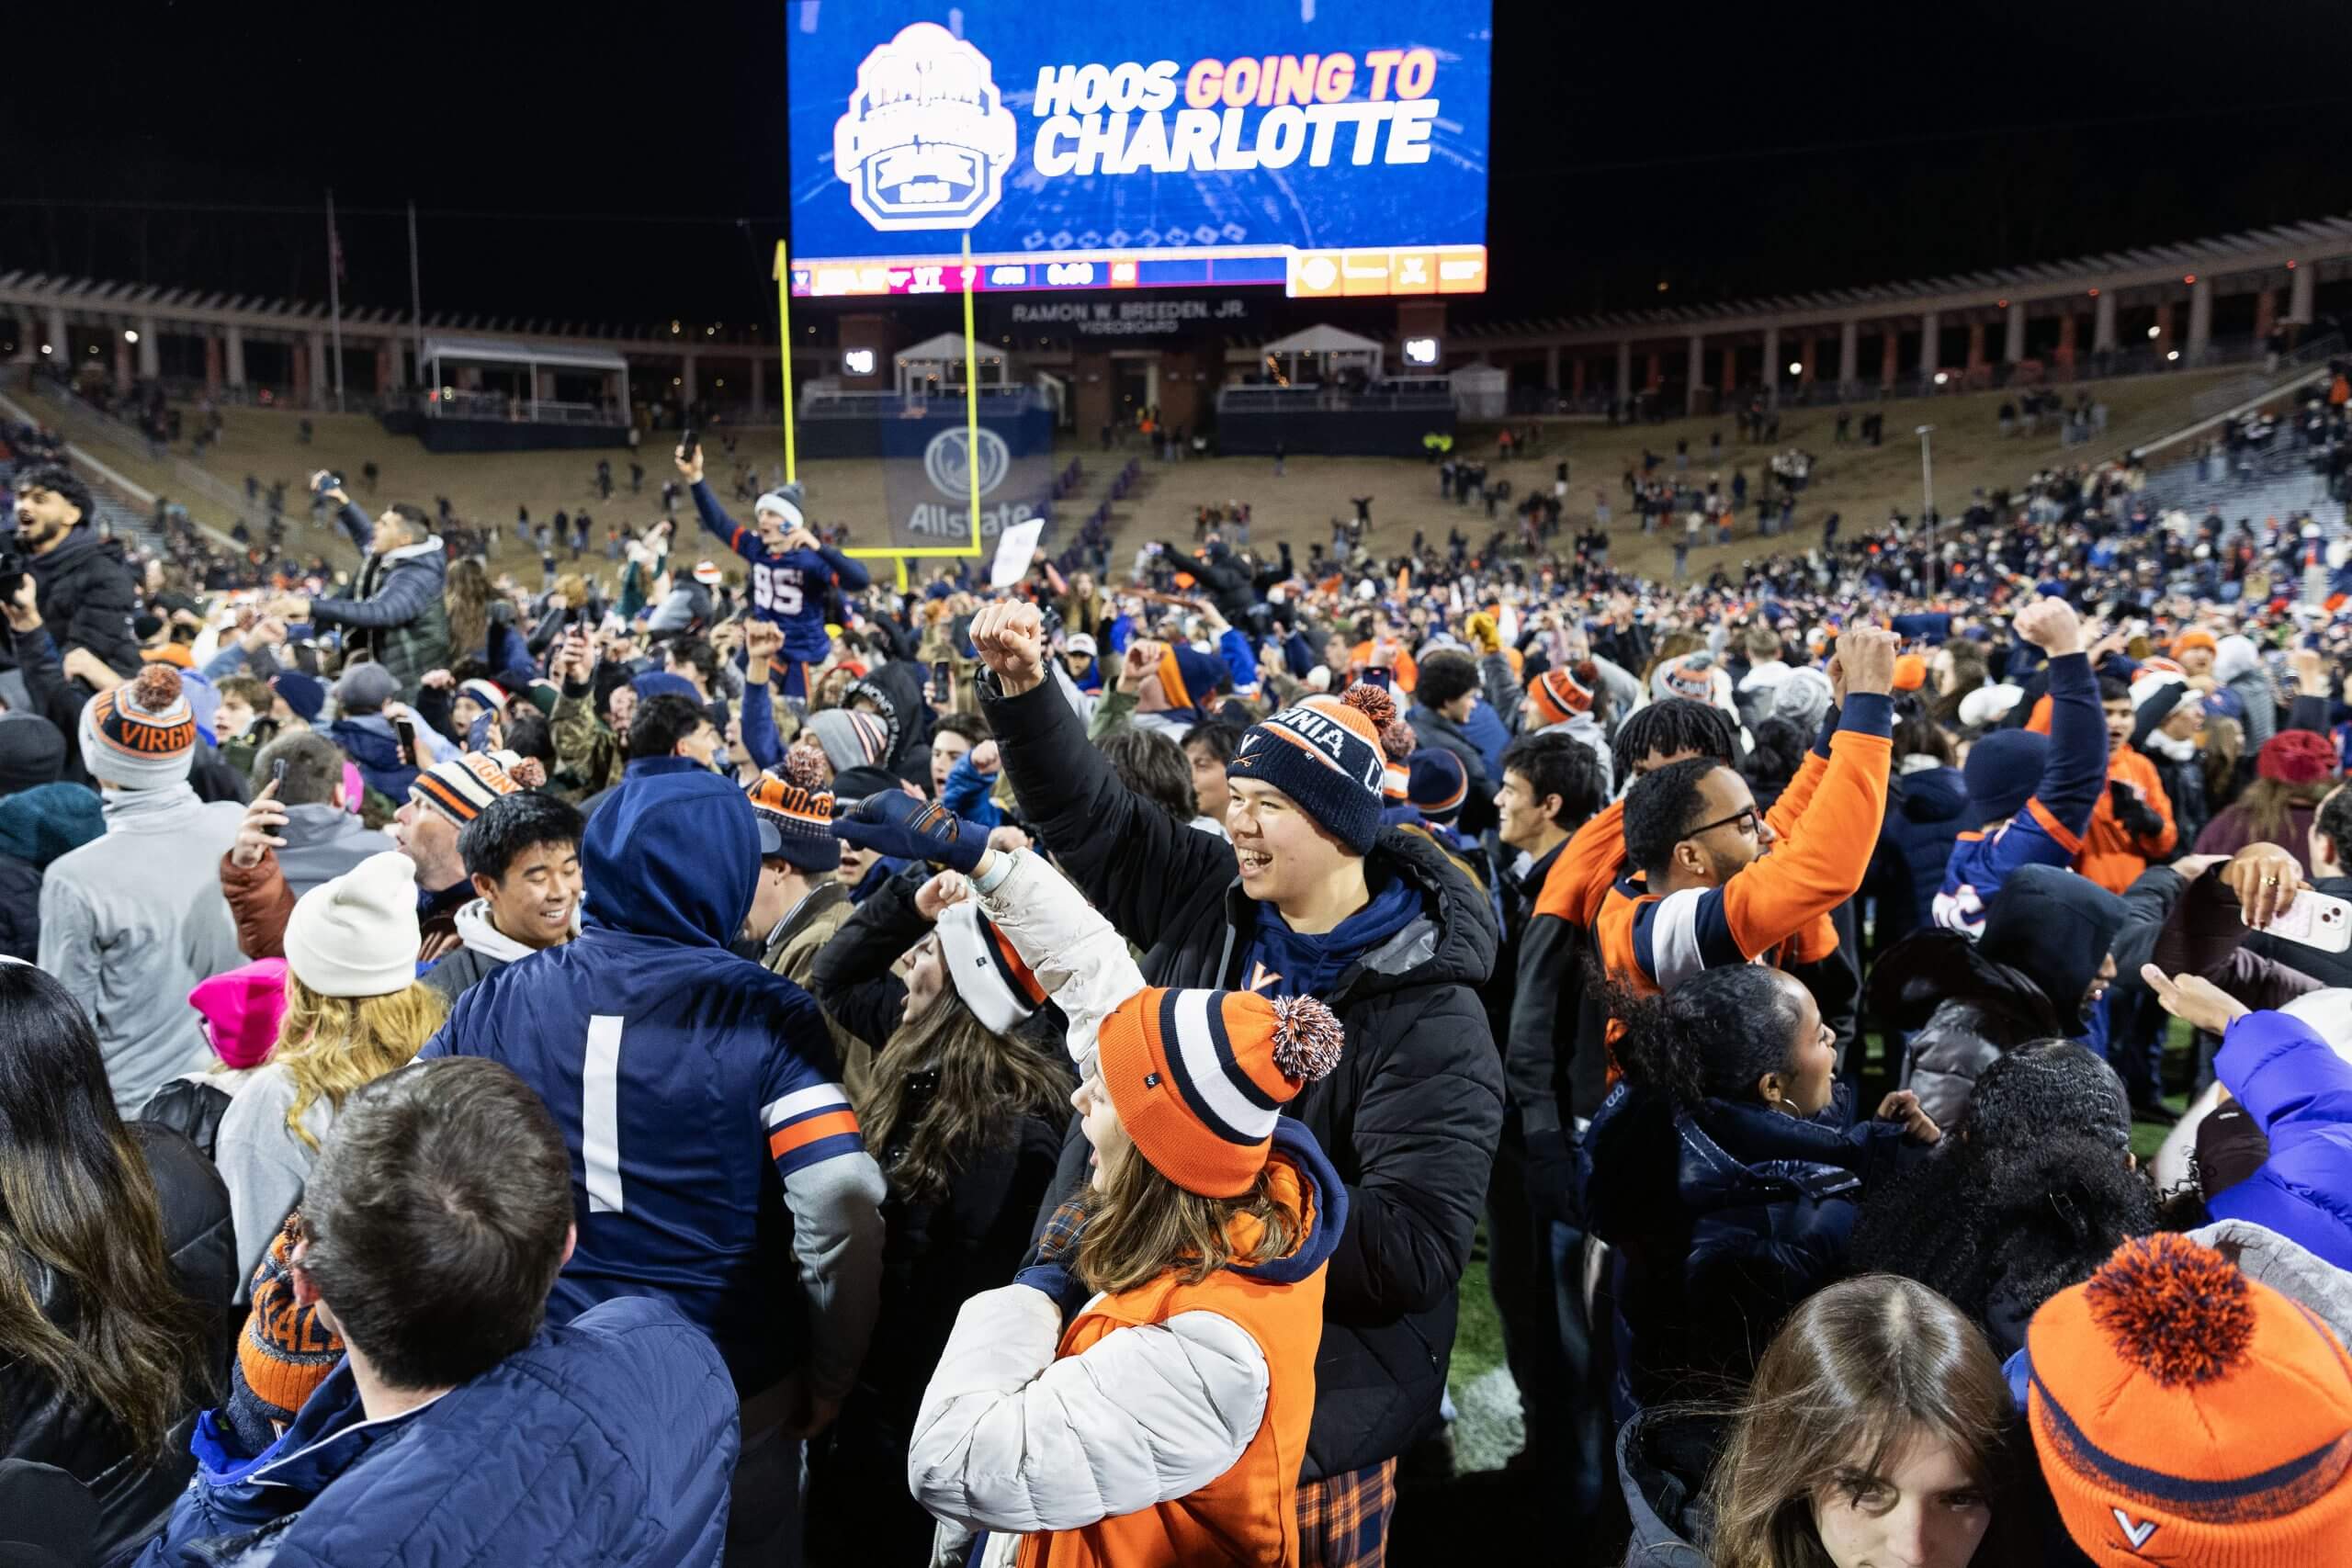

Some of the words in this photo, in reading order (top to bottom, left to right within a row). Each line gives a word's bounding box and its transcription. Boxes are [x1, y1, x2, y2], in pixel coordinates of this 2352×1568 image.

[1033, 61, 1180, 117] HOOS
[1185, 51, 1355, 109] GOING
[1365, 49, 1437, 101] TO
[1033, 99, 1440, 176] CHARLOTTE
[1012, 303, 1088, 321] RAMON
[1077, 321, 1179, 334] VIDEOBOARD
[582, 1014, 624, 1213] 1
